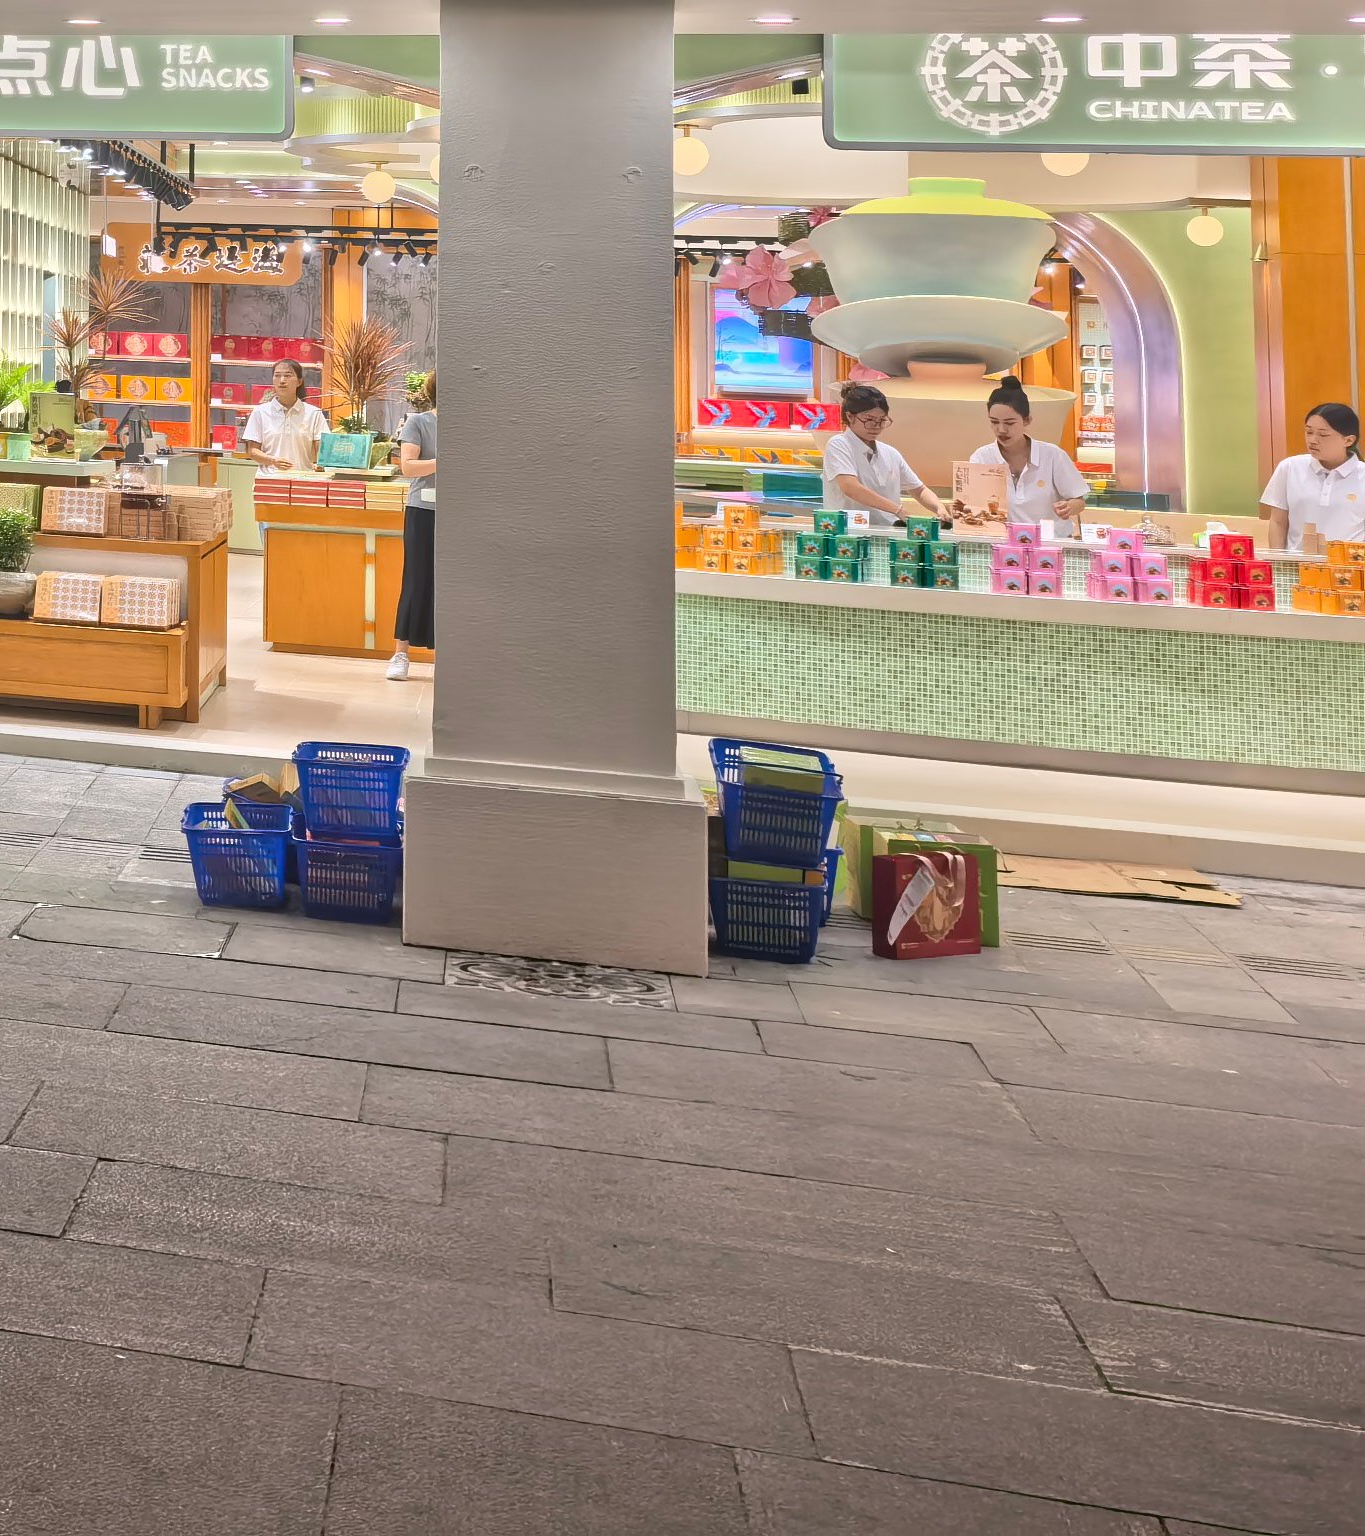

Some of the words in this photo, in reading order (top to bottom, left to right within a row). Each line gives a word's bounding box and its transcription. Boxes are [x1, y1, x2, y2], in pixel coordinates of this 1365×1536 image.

[160, 44, 214, 65] TEA
[160, 67, 270, 92] SNACKS
[1088, 100, 1297, 122] CHINATEA
